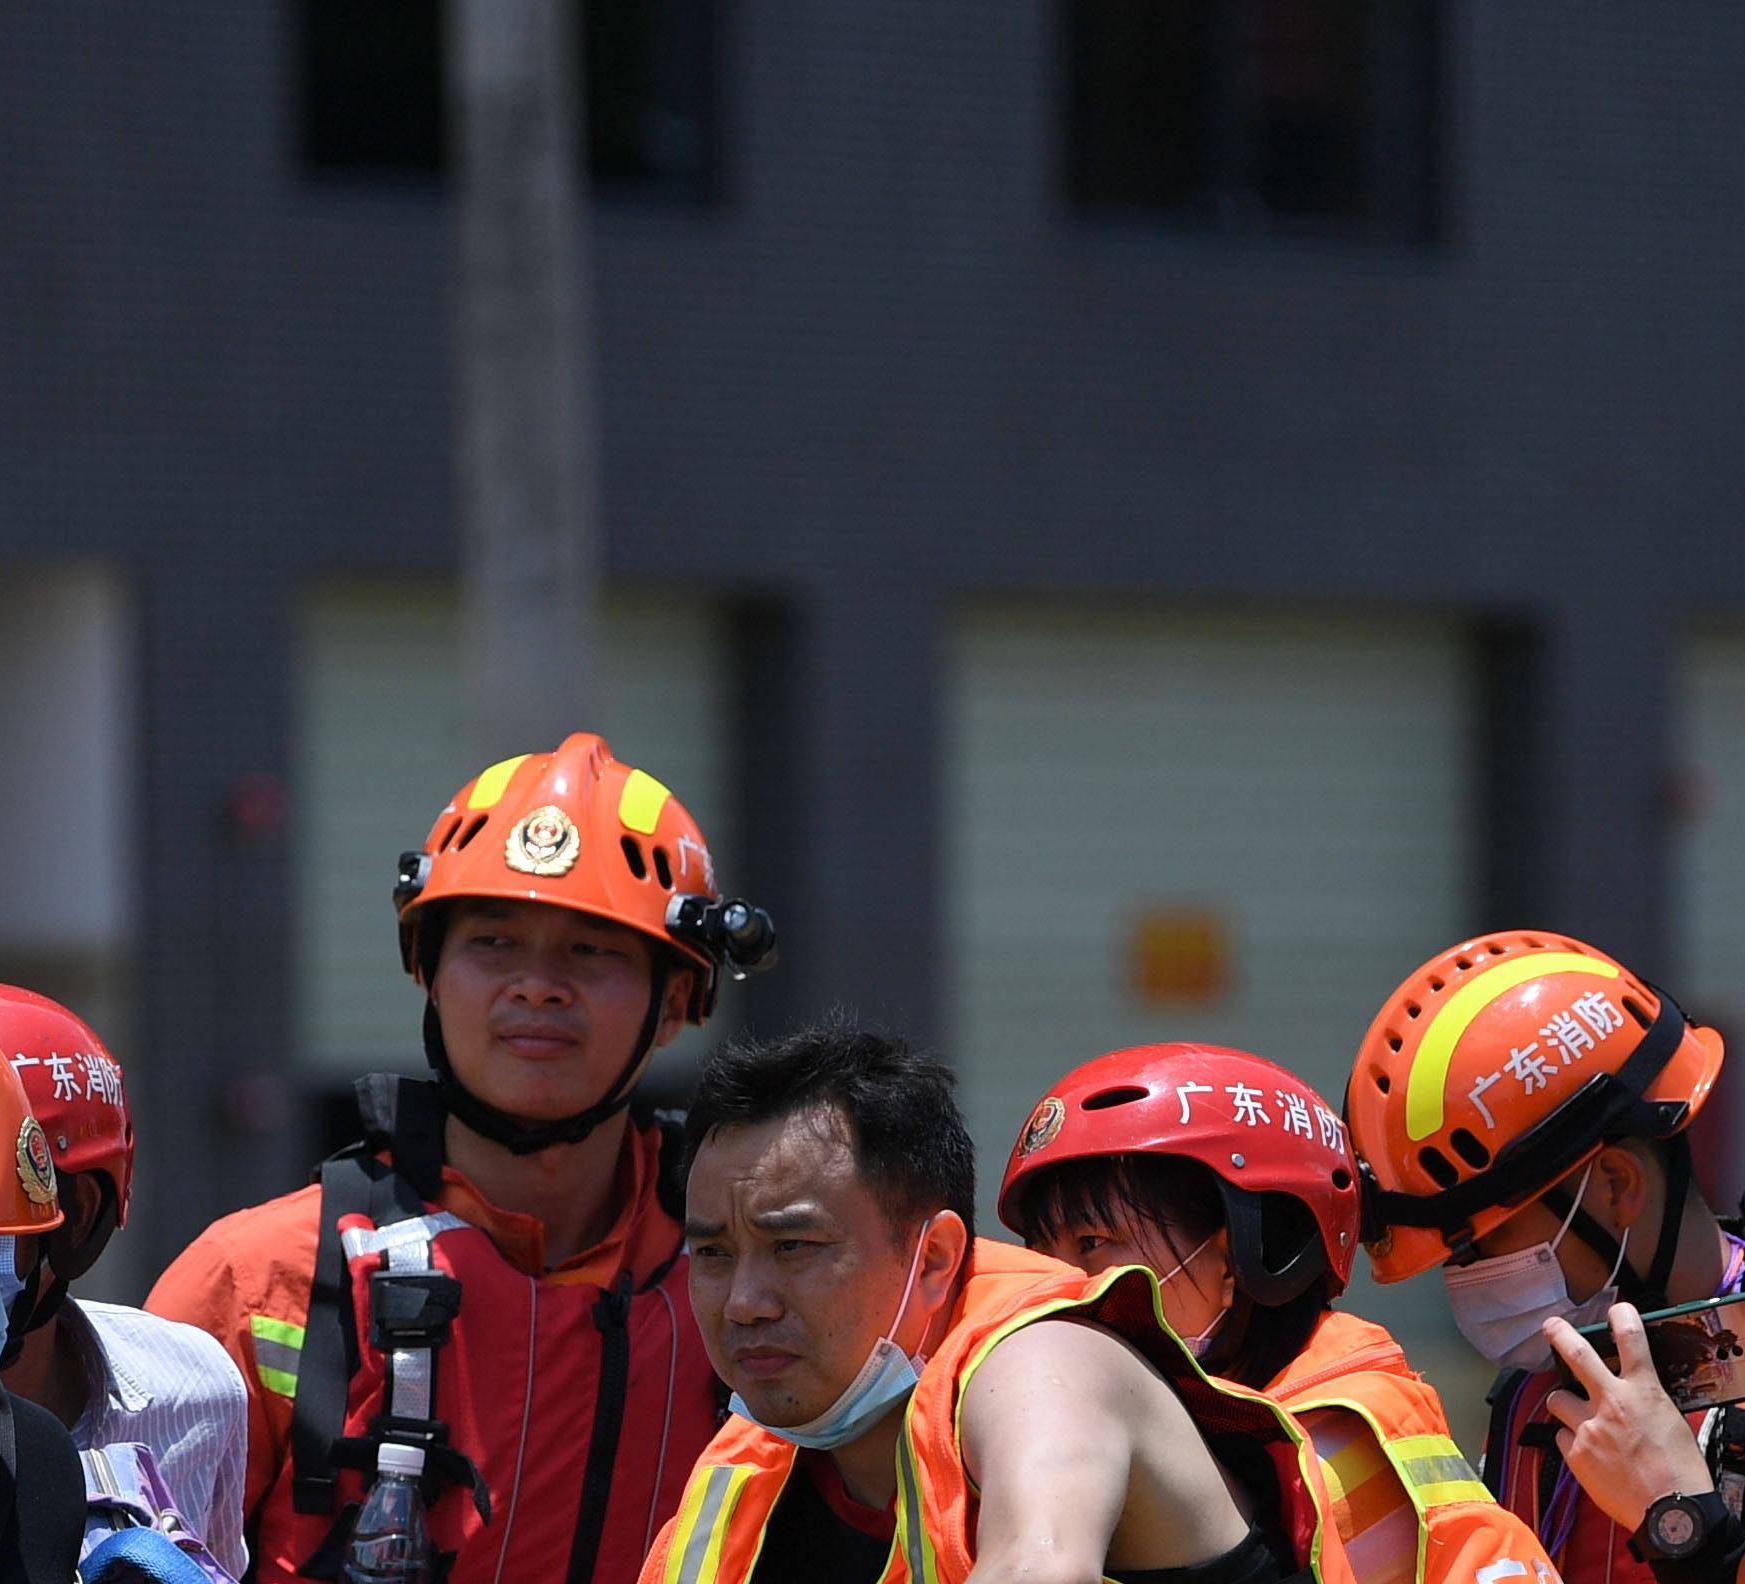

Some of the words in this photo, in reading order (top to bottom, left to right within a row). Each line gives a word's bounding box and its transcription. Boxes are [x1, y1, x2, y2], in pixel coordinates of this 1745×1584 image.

[9, 1052, 123, 1107] 广东消防
[1468, 991, 1624, 1129] 广东消防
[1176, 1081, 1346, 1155] 广东消防
